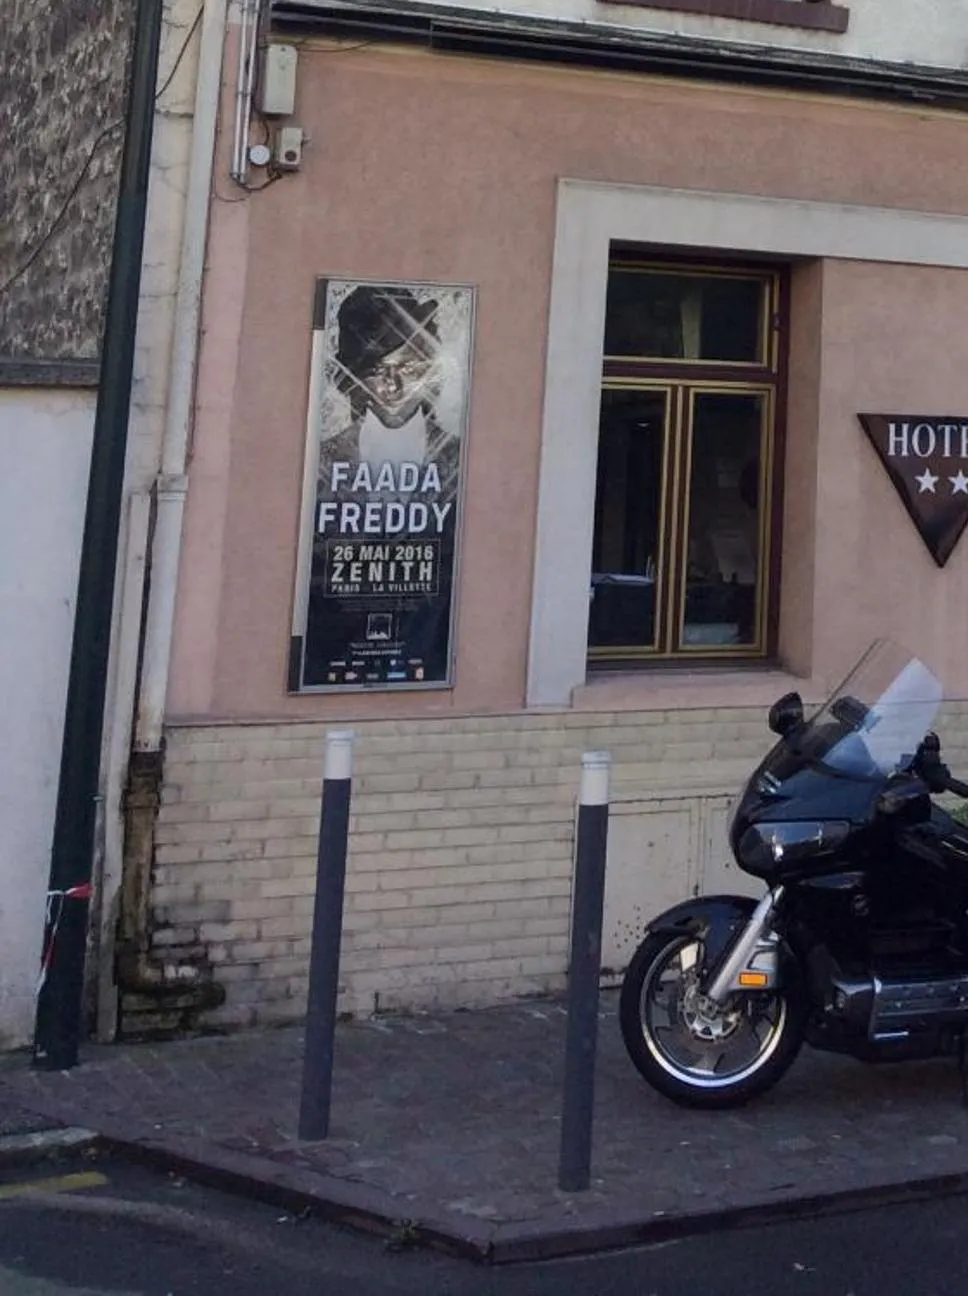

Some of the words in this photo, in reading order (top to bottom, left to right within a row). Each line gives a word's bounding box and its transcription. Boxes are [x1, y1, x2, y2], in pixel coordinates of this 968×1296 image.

[331, 461, 441, 492] FAADA
[318, 502, 452, 533] FREDDY
[333, 545, 353, 561] 26
[359, 545, 390, 561] MAI
[394, 545, 434, 561] 2016
[331, 562, 433, 582] ZENITH
